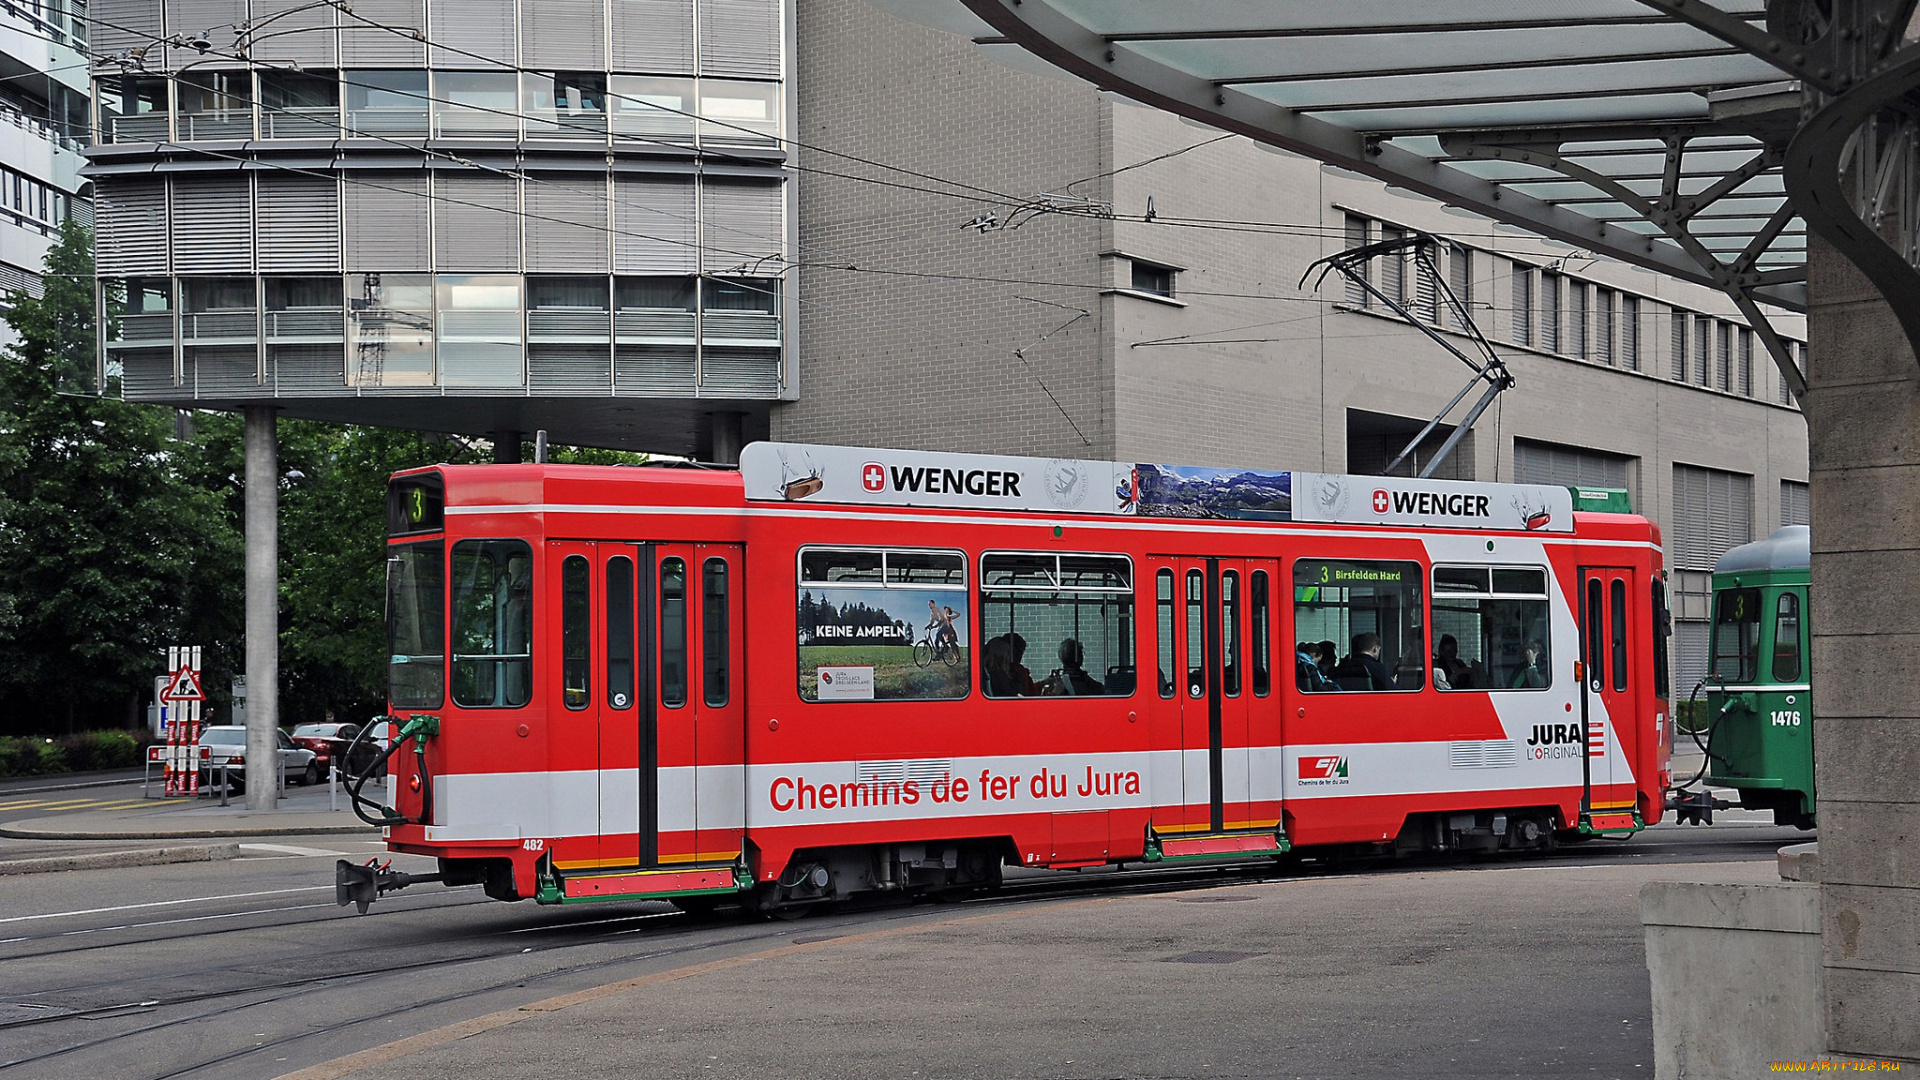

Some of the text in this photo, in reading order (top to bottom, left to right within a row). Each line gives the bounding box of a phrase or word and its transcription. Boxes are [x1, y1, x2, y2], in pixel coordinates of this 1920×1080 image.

[890, 466, 1021, 497] WENGER
[412, 488, 422, 523] 3
[1392, 491, 1490, 517] WENGER
[1321, 566, 1401, 583] 3 Birsfelden Hard
[1735, 594, 1744, 619] 3
[816, 625, 905, 638] KEINE AMPELN
[1770, 711, 1801, 726] 1476
[1527, 723, 1582, 746] JURA
[769, 766, 1141, 812] Chemins de fer du Jura
[523, 839, 544, 851] 482
